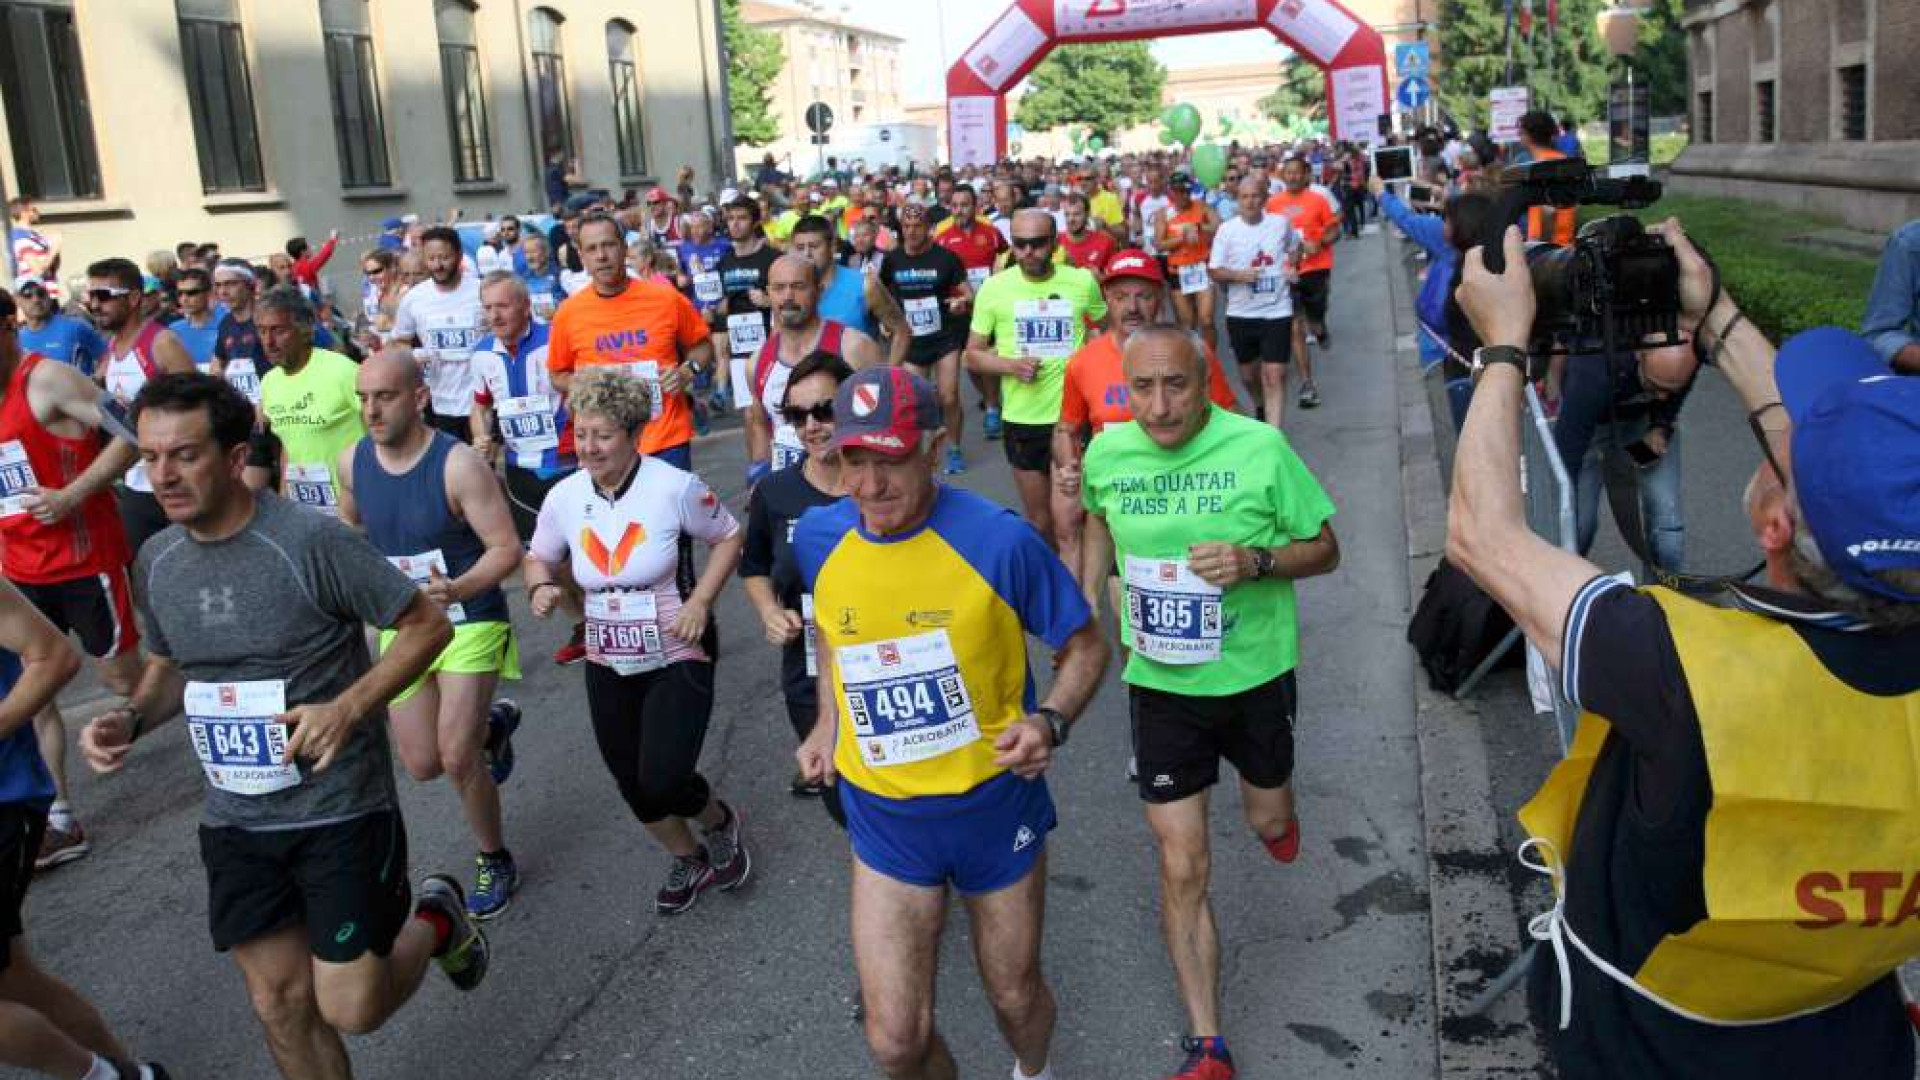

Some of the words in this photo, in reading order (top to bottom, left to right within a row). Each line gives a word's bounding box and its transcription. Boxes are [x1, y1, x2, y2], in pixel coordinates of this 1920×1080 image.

[596, 329, 648, 351] AVIS
[1153, 471, 1237, 493] QUATAR
[1121, 496, 1168, 515] PASS
[1175, 497, 1188, 515] A
[1196, 494, 1223, 515] PE
[1146, 597, 1193, 629] 365
[598, 623, 642, 648] F160
[875, 681, 936, 722] 494
[212, 724, 260, 755] 643
[902, 717, 969, 746] ACROBATIC
[1795, 870, 1920, 930] STA
